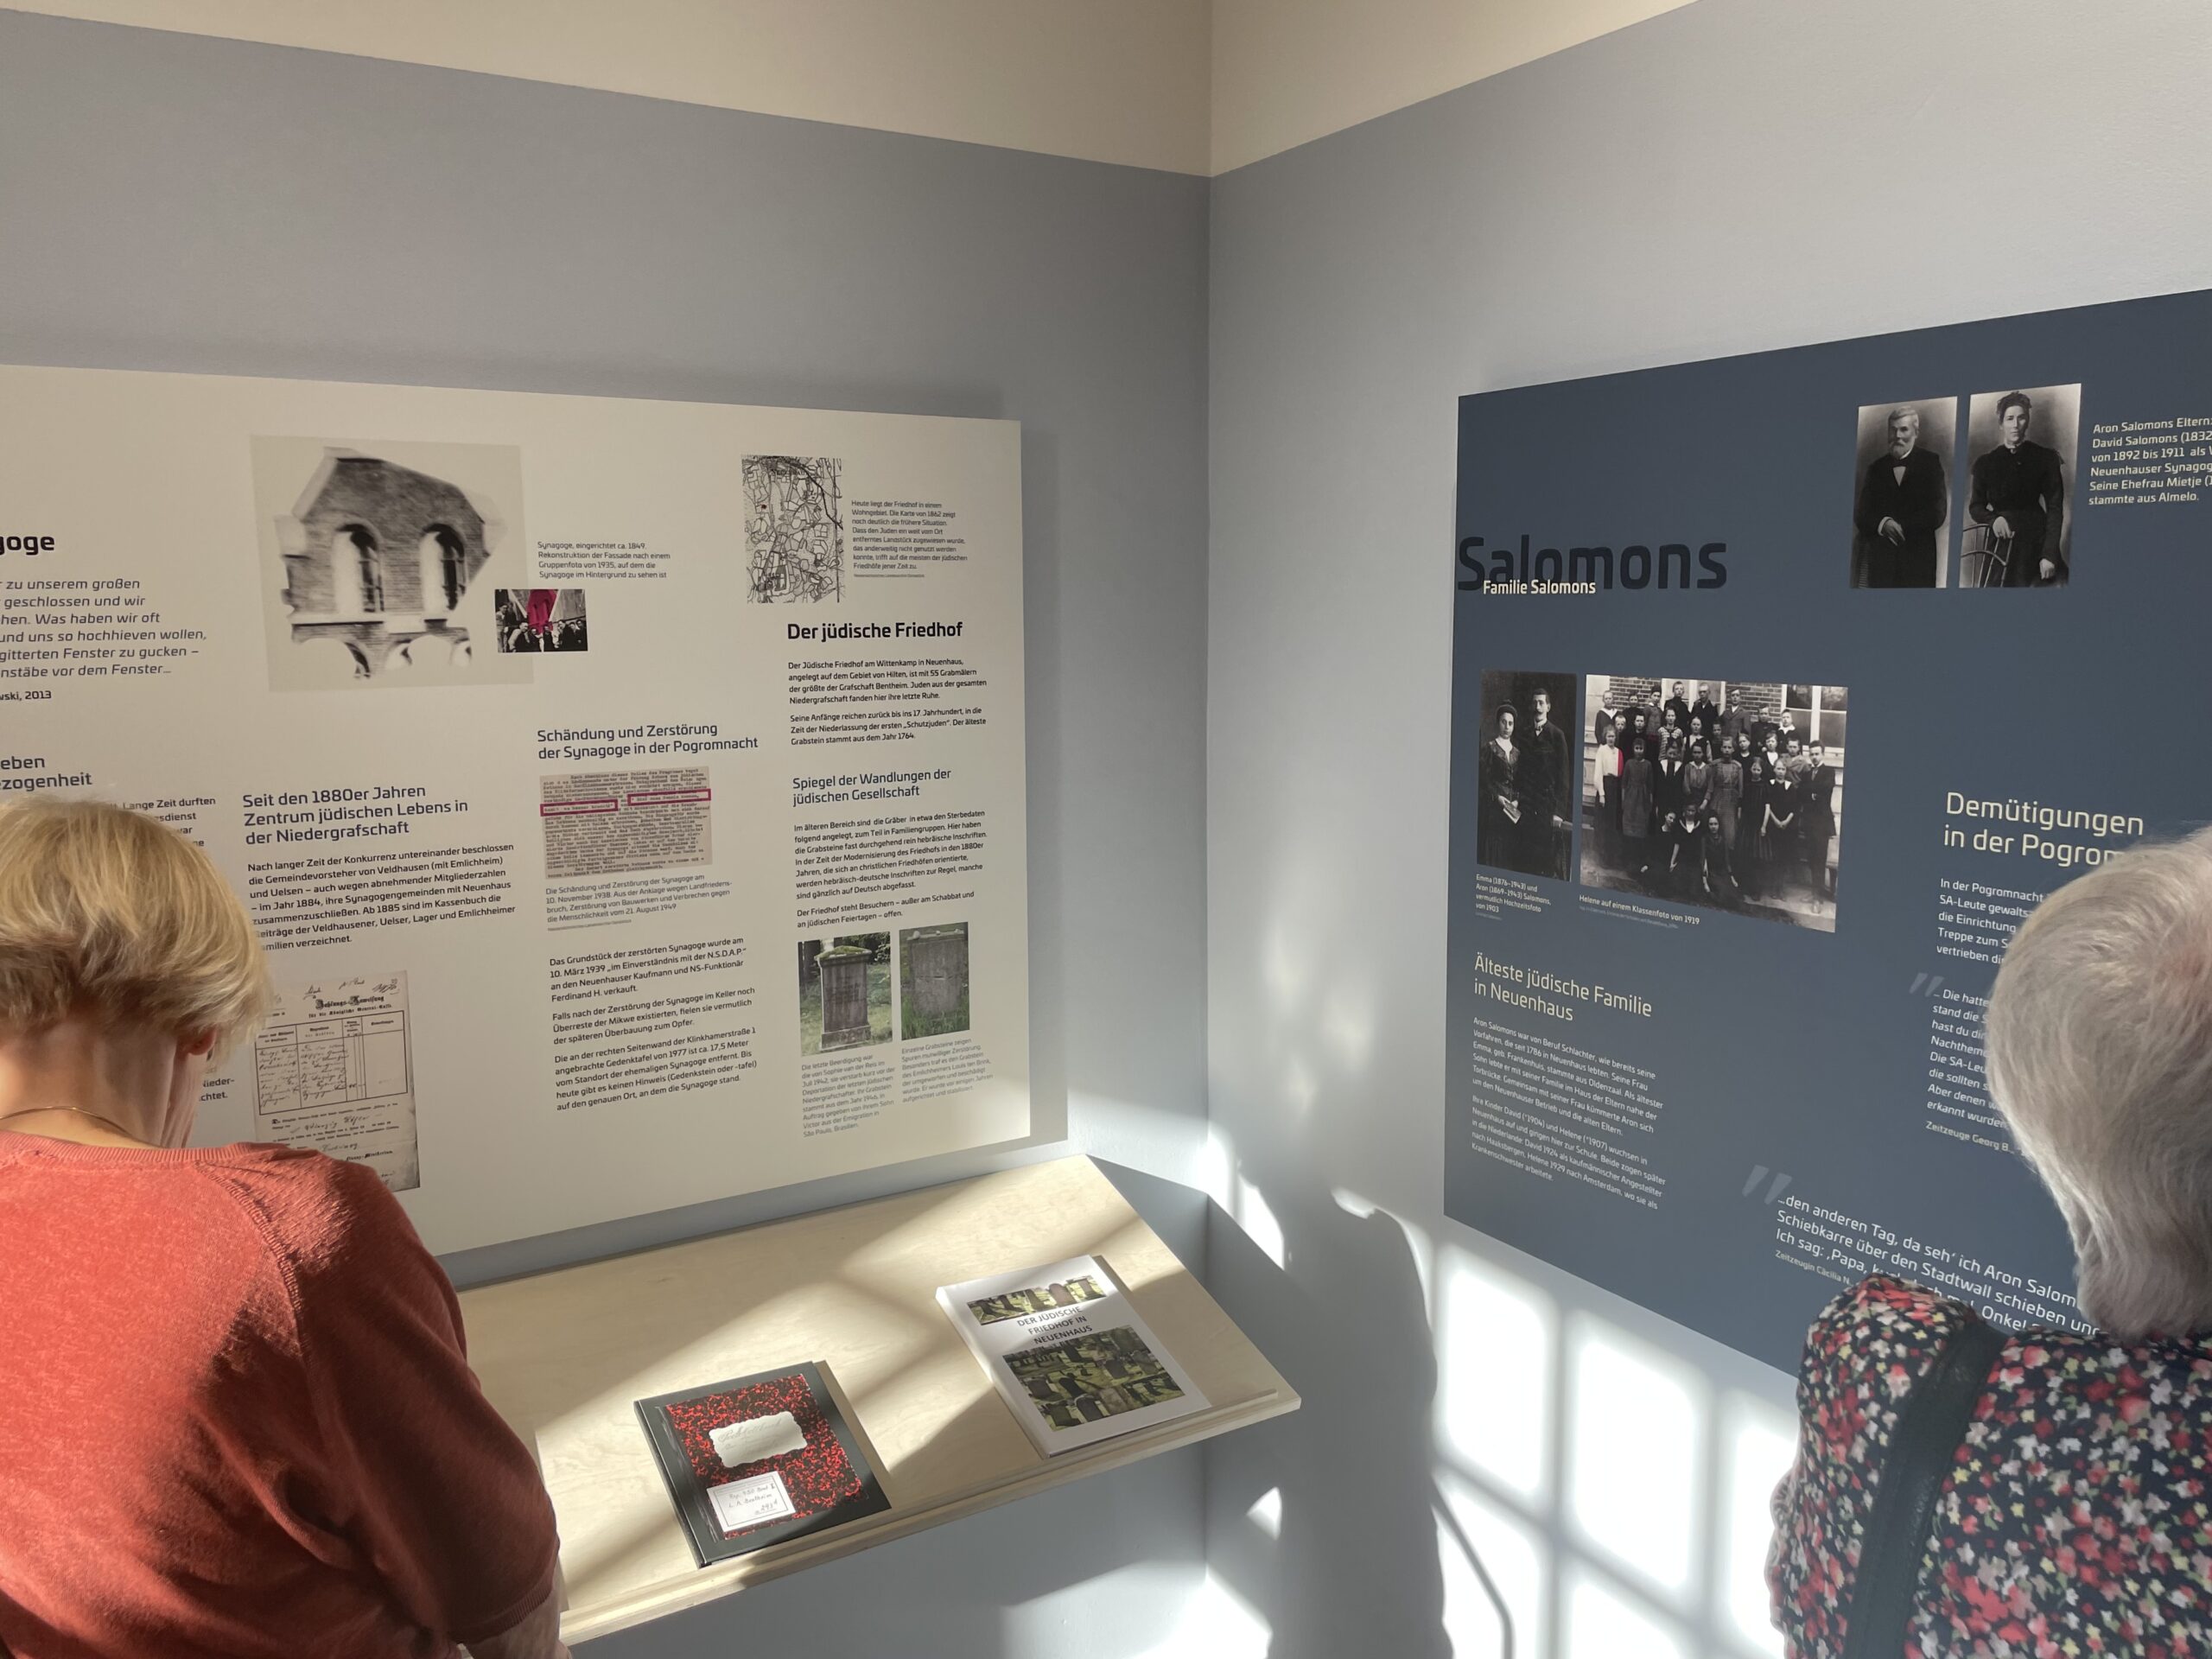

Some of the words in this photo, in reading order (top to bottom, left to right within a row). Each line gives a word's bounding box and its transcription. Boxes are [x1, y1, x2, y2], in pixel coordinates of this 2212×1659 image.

[2094, 424, 2118, 433] Aron
[2121, 421, 2173, 431] Salomons
[2093, 437, 2122, 448] David
[2126, 435, 2177, 446] Salomons
[2092, 454, 2110, 462] von
[2113, 451, 2139, 461] 1892
[2143, 449, 2158, 459] bis
[2161, 448, 2184, 458] 1911
[2190, 447, 2205, 455] als
[2091, 466, 2161, 476] Neuenhauser
[2089, 481, 2118, 491] Seine
[2121, 480, 2164, 489] Ehefrau
[2167, 477, 2202, 487] Mietje
[2088, 495, 2134, 505] stammte
[2158, 493, 2199, 502] Almelo.
[537, 541, 575, 550] Synagoge,
[1458, 535, 1726, 590] Salomons
[5, 581, 22, 589] zu
[27, 581, 87, 589] unserem
[92, 577, 140, 591] großen
[1483, 580, 1527, 594] Familie
[1531, 579, 1596, 594] Salomons
[3, 595, 90, 610] geschlossen
[94, 595, 120, 607] und
[124, 595, 145, 606] wir
[35, 613, 66, 625] Was
[70, 613, 112, 624] haben
[116, 612, 138, 623] wir
[141, 612, 160, 623] oft
[28, 633, 54, 642] uns
[57, 632, 73, 641] so
[77, 629, 156, 641] hochhieven
[159, 628, 207, 640] wollen,
[787, 623, 818, 639] Der
[821, 622, 891, 643] jüdische
[895, 621, 963, 638] Friedhof
[63, 647, 117, 659] Fenster
[118, 649, 135, 658] zu
[138, 645, 187, 659] gucken
[52, 667, 74, 677] vor
[78, 664, 107, 676] dem
[787, 661, 801, 670] Der
[802, 660, 834, 669] Jüdische
[834, 659, 863, 668] Friedhof
[24, 690, 52, 700] 2013
[537, 728, 614, 742] Schändung
[618, 725, 643, 738] und
[646, 723, 717, 737] Zerstörung
[537, 747, 561, 760] der
[563, 745, 631, 760] Synagoge
[633, 742, 645, 753] in
[649, 741, 671, 753] der
[673, 736, 758, 753] Pogromnacht
[0, 772, 92, 791] zogenheit
[792, 775, 836, 791] Spiegel
[838, 774, 857, 785] der
[859, 771, 931, 785] Wandlungen
[933, 768, 951, 779] der
[242, 793, 275, 808] Seit
[278, 791, 308, 805] den
[311, 788, 369, 804] 1880er
[372, 785, 426, 799] Jahren
[792, 791, 849, 807] jüdischen
[851, 785, 919, 800] Gesellschaft
[244, 812, 315, 826] Zentrum
[318, 805, 393, 824] jüdischen
[397, 802, 451, 816] Lebens
[454, 799, 467, 811] in
[1947, 791, 2143, 836] Demütigungen
[245, 831, 272, 845] der
[276, 821, 410, 842] Niedergrafschaft
[1944, 824, 1964, 848] in
[1974, 829, 2014, 853] der
[247, 861, 273, 872] Nach
[275, 861, 305, 870] langer
[306, 857, 325, 867] Zeit
[327, 856, 342, 866] der
[344, 853, 397, 864] Konkurrenz
[397, 848, 461, 860] untereinander
[461, 844, 514, 855] beschlossen
[1941, 878, 1949, 888] In
[1953, 880, 1968, 891] der
[1972, 883, 2043, 902] Pogromnacht
[1580, 895, 1600, 906] Helene
[1602, 899, 1611, 907] auf
[1612, 900, 1630, 911] einem
[1632, 906, 1669, 919] Klassenfoto
[1671, 913, 1682, 922] von
[1684, 916, 1700, 925] 1919
[1939, 896, 1986, 911] SA-Leute
[1939, 912, 1953, 922] die
[1956, 915, 2016, 933] Einrichtung
[1939, 927, 1974, 943] Treppe
[1976, 936, 1998, 947] zum
[566, 951, 612, 964] Grundstück
[627, 946, 667, 957] zerstörten
[668, 942, 706, 953] Synagoge
[707, 938, 731, 947] wurde
[1937, 945, 1988, 962] vertrieben
[1475, 951, 1522, 982] Älteste
[1527, 969, 1589, 1000] jüdische
[1594, 986, 1651, 1016] Familie
[1474, 978, 1486, 995] in
[1491, 983, 1573, 1020] Neuenhaus
[1777, 1229, 1794, 1245] Ich
[1798, 1237, 1824, 1257] sag:
[1814, 1205, 1866, 1234] anderen
[1871, 1224, 1898, 1246] Tag,
[1903, 1235, 1921, 1252] da
[1959, 1255, 1980, 1274] ich
[1984, 1265, 2023, 1288] Aron
[1776, 1250, 1815, 1272] Zeitzeugin
[1777, 1210, 1853, 1248] Schiebkarre
[1856, 1240, 1888, 1261] über
[1891, 1251, 1917, 1272] den
[1921, 1263, 1990, 1299] Stadtwall
[1995, 1288, 2065, 1326] schieben
[1039, 1306, 1082, 1322] JÜDISCHE
[1982, 1306, 2026, 1331] Onkel
[1028, 1320, 1073, 1335] FRIEDHOF
[1076, 1315, 1087, 1325] IN
[1034, 1325, 1092, 1344] NEUENHAUS
